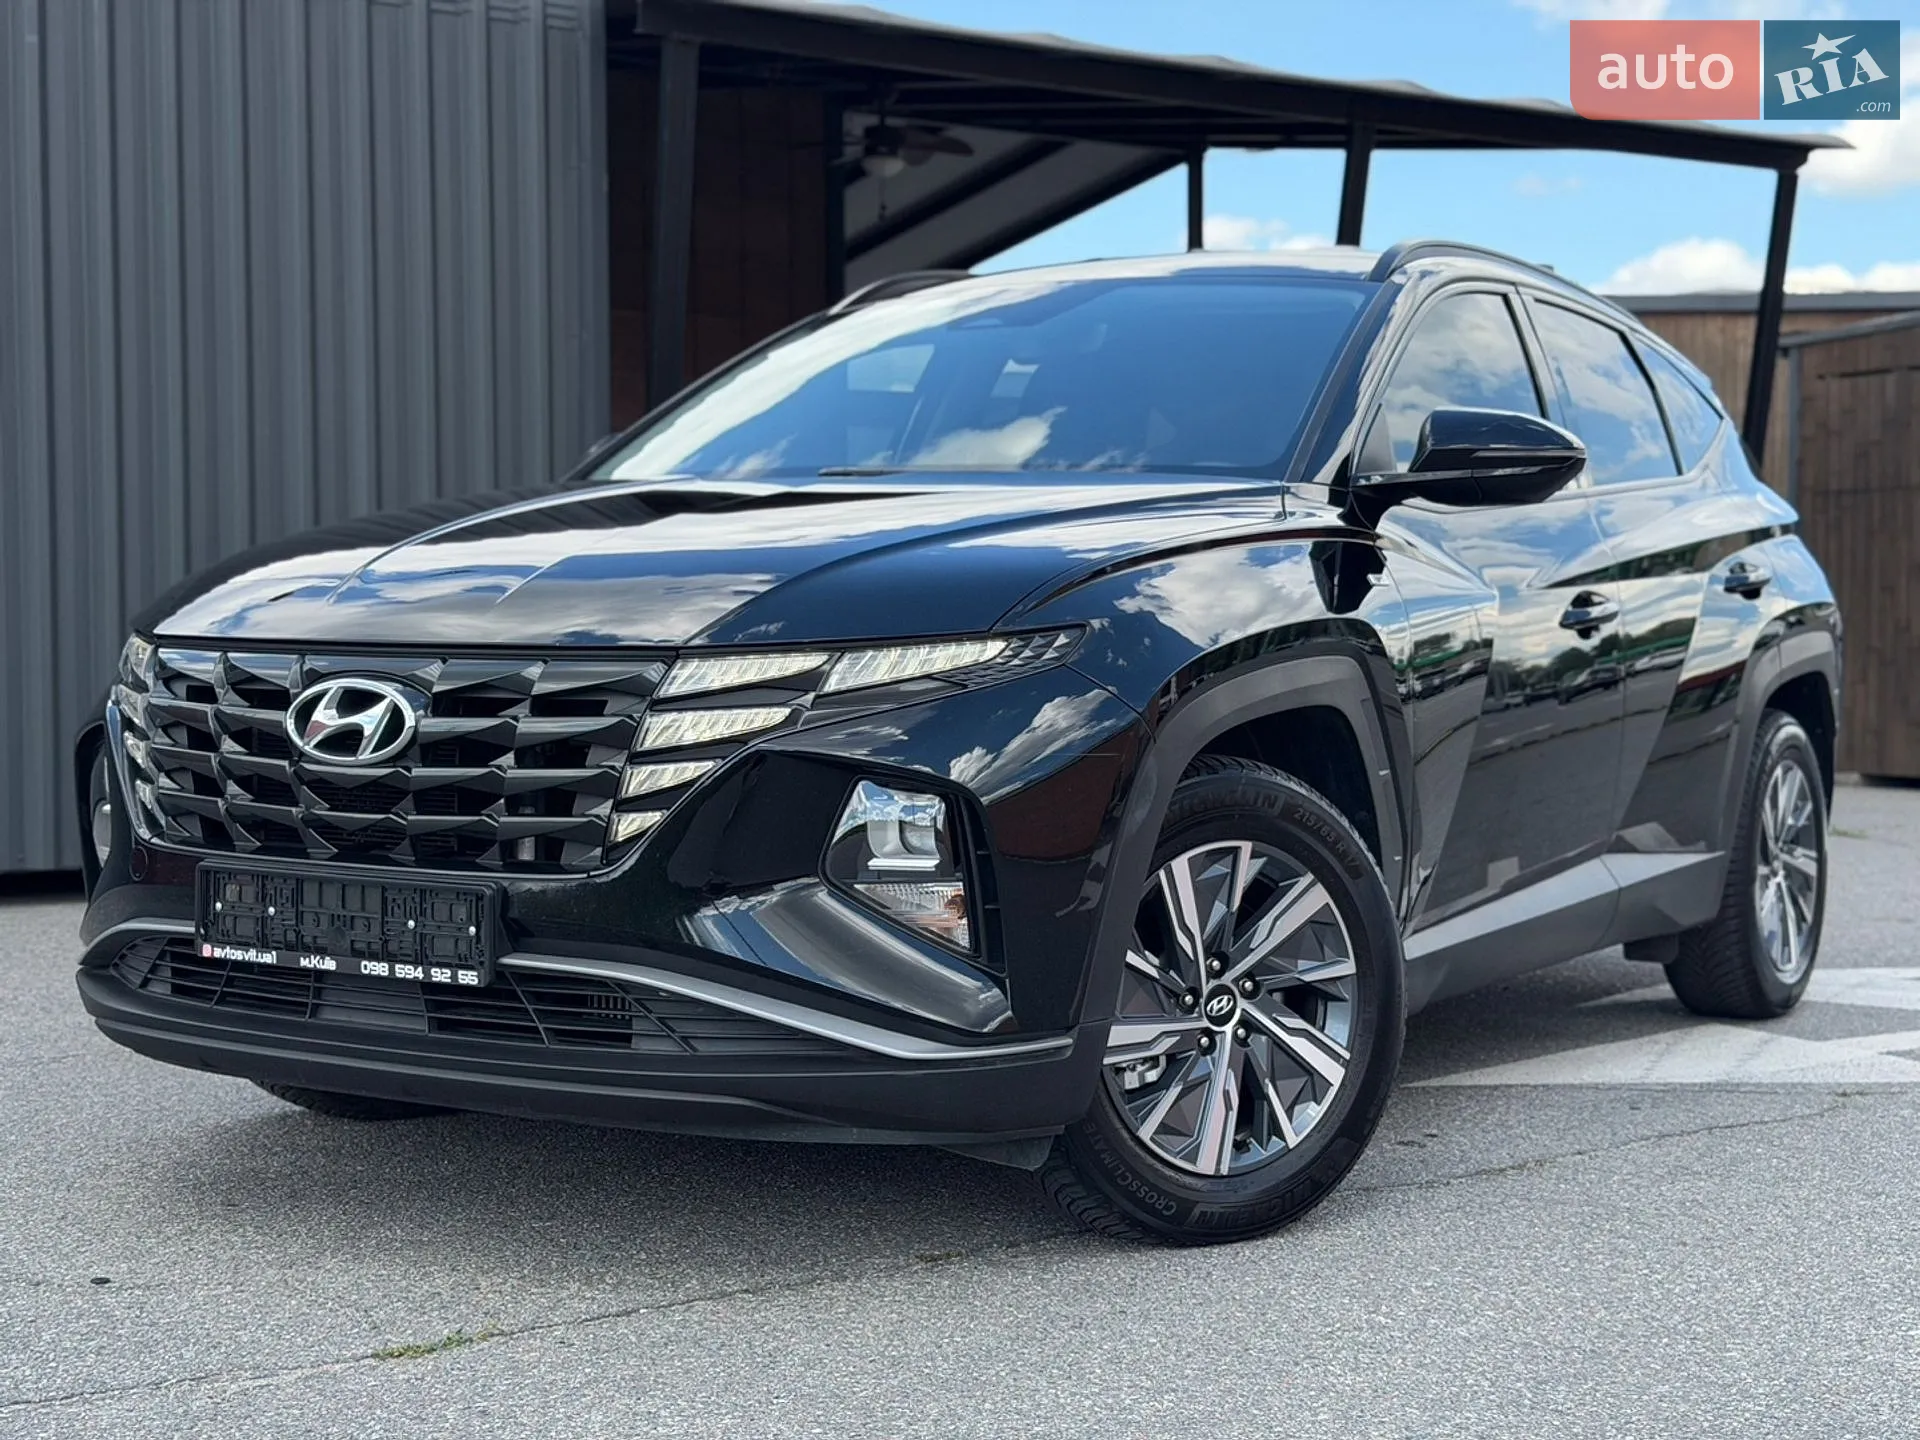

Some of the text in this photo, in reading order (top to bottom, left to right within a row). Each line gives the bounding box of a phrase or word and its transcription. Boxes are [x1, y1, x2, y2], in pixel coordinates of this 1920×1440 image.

[361, 960, 480, 986] 098 594 92 55
